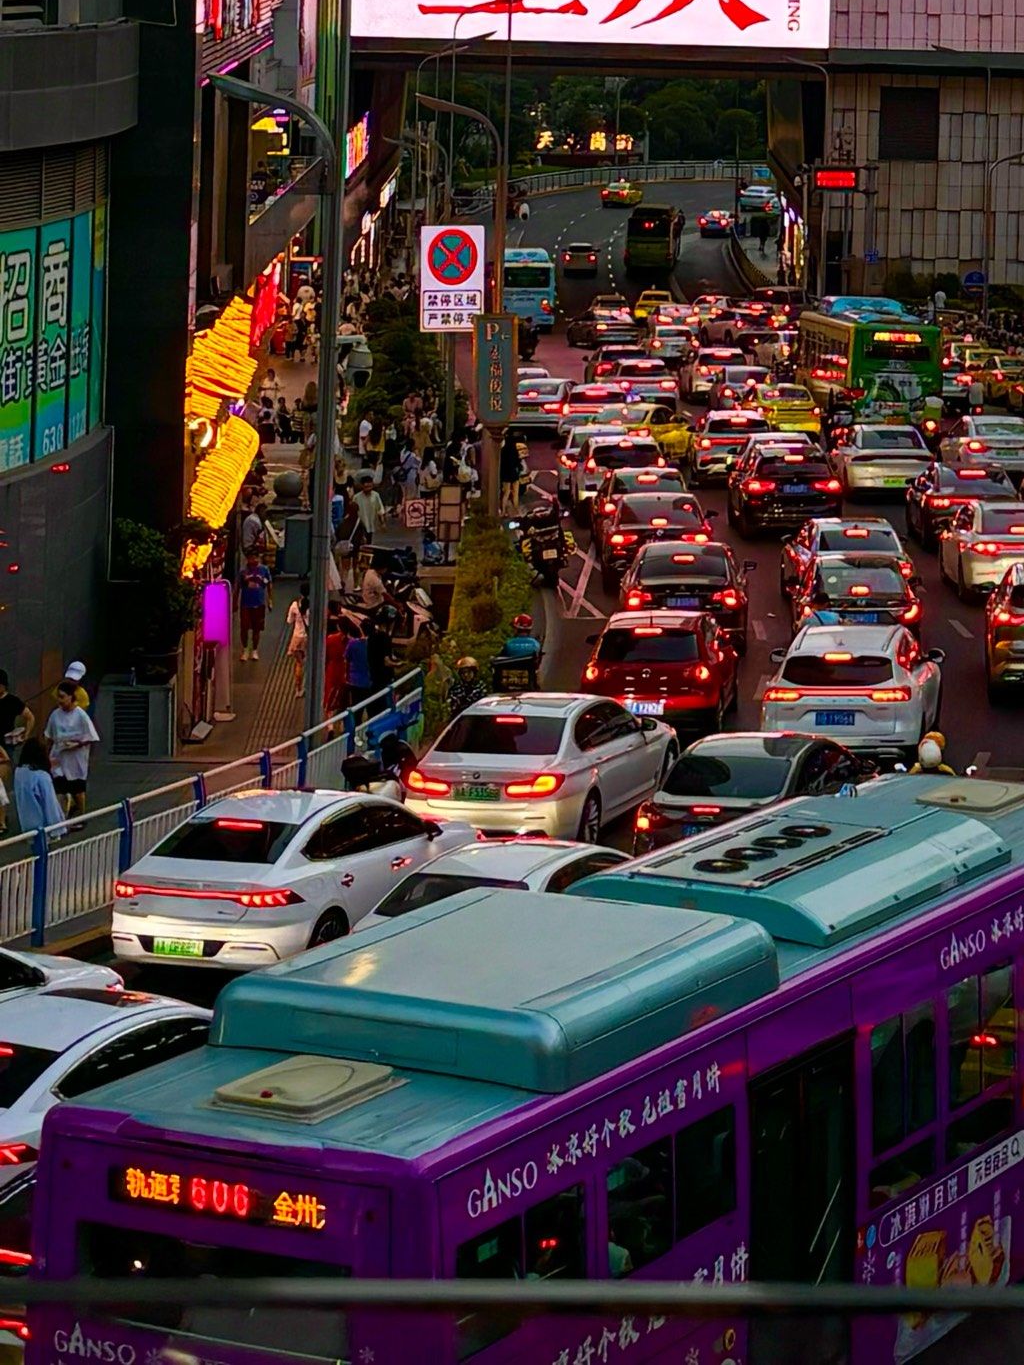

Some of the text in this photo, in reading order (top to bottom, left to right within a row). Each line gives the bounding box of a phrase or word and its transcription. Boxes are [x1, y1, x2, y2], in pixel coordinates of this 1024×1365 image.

[428, 293, 477, 307] 禁停区域
[941, 929, 986, 970] GANSO
[191, 1178, 249, 1216] 606
[467, 1161, 538, 1218] GANSO
[54, 1323, 136, 1364] GANSO
